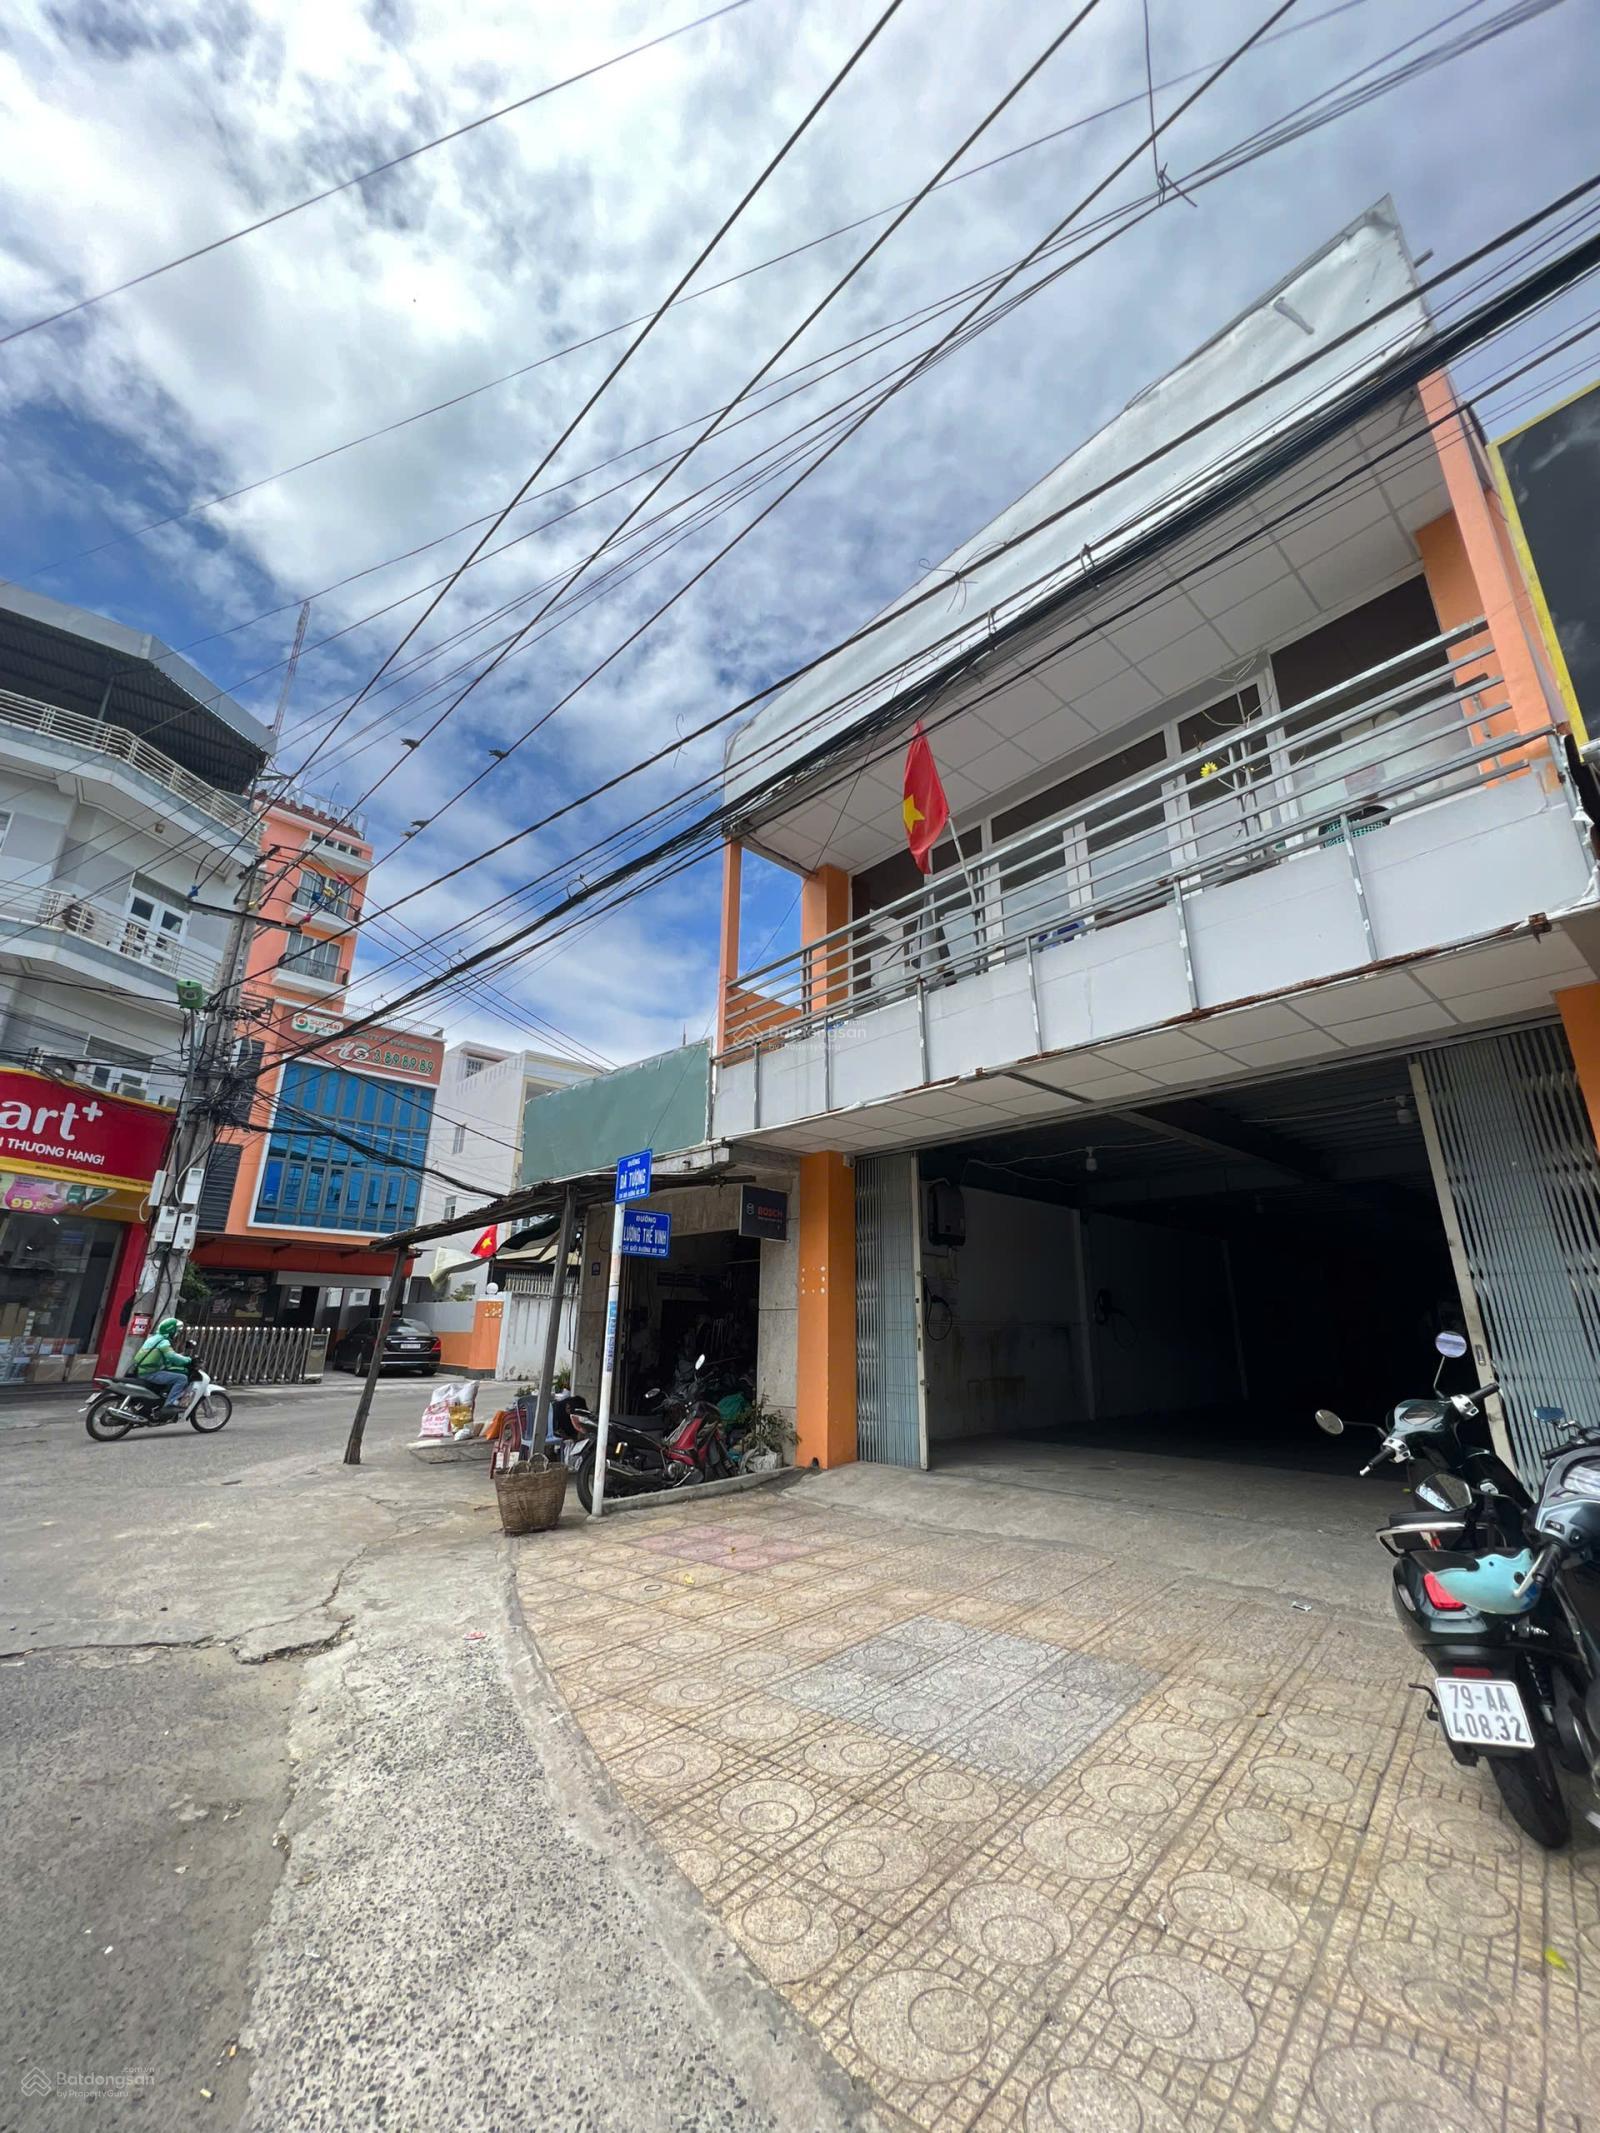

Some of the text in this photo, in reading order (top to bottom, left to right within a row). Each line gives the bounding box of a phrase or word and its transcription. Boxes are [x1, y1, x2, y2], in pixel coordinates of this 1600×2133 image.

[66, 1149, 105, 1166] HẠNG!
[757, 1206, 784, 1219] BOSCH
[643, 1224, 655, 1244] THẾ
[655, 1229, 667, 1245] VINH
[1448, 1684, 1511, 1713] 79-AA
[1453, 1712, 1527, 1743] 408.32
